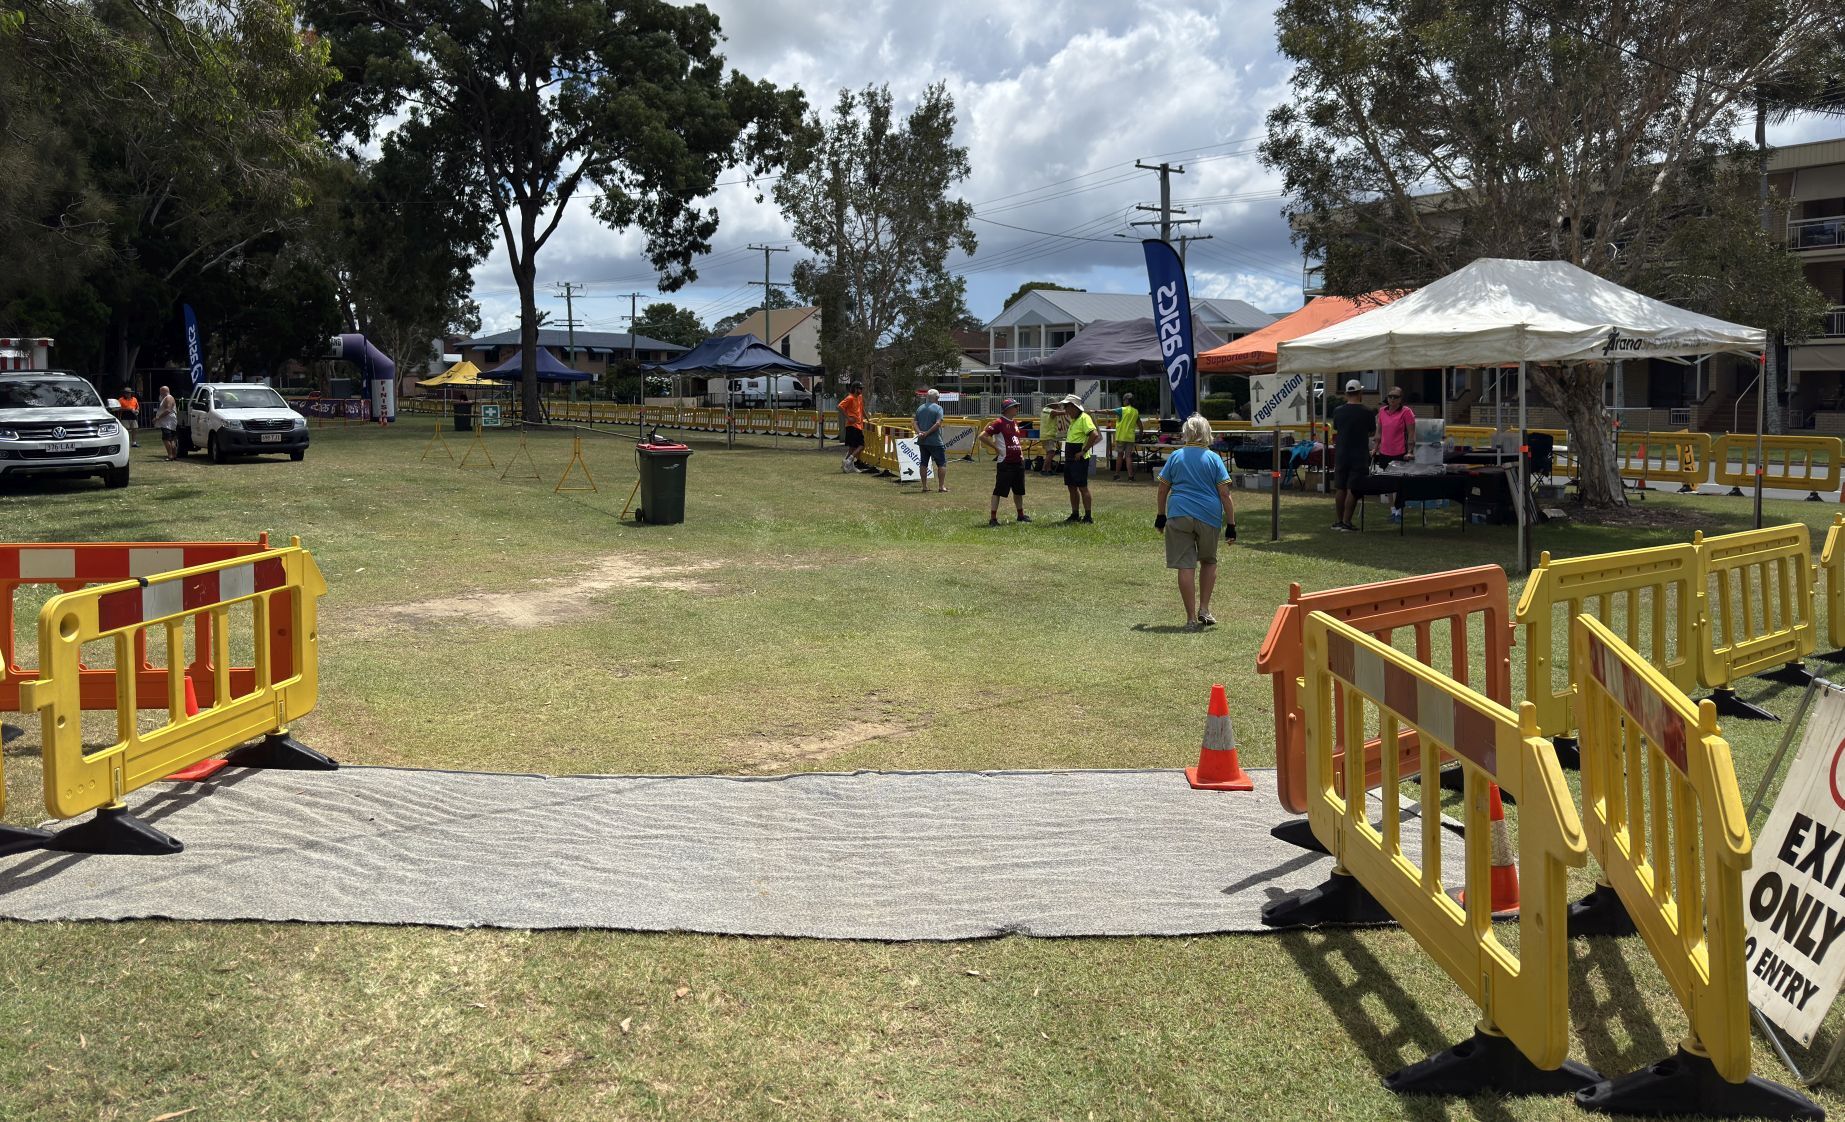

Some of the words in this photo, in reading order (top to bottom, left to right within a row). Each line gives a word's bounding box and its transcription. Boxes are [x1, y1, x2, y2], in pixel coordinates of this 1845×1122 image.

[1206, 353, 1249, 366] Supported
[380, 380, 388, 416] FINISH
[1254, 374, 1304, 424] registration
[1777, 812, 1845, 898] EXI
[1750, 871, 1845, 966] ONLY
[1752, 947, 1821, 1012] ENTRY
